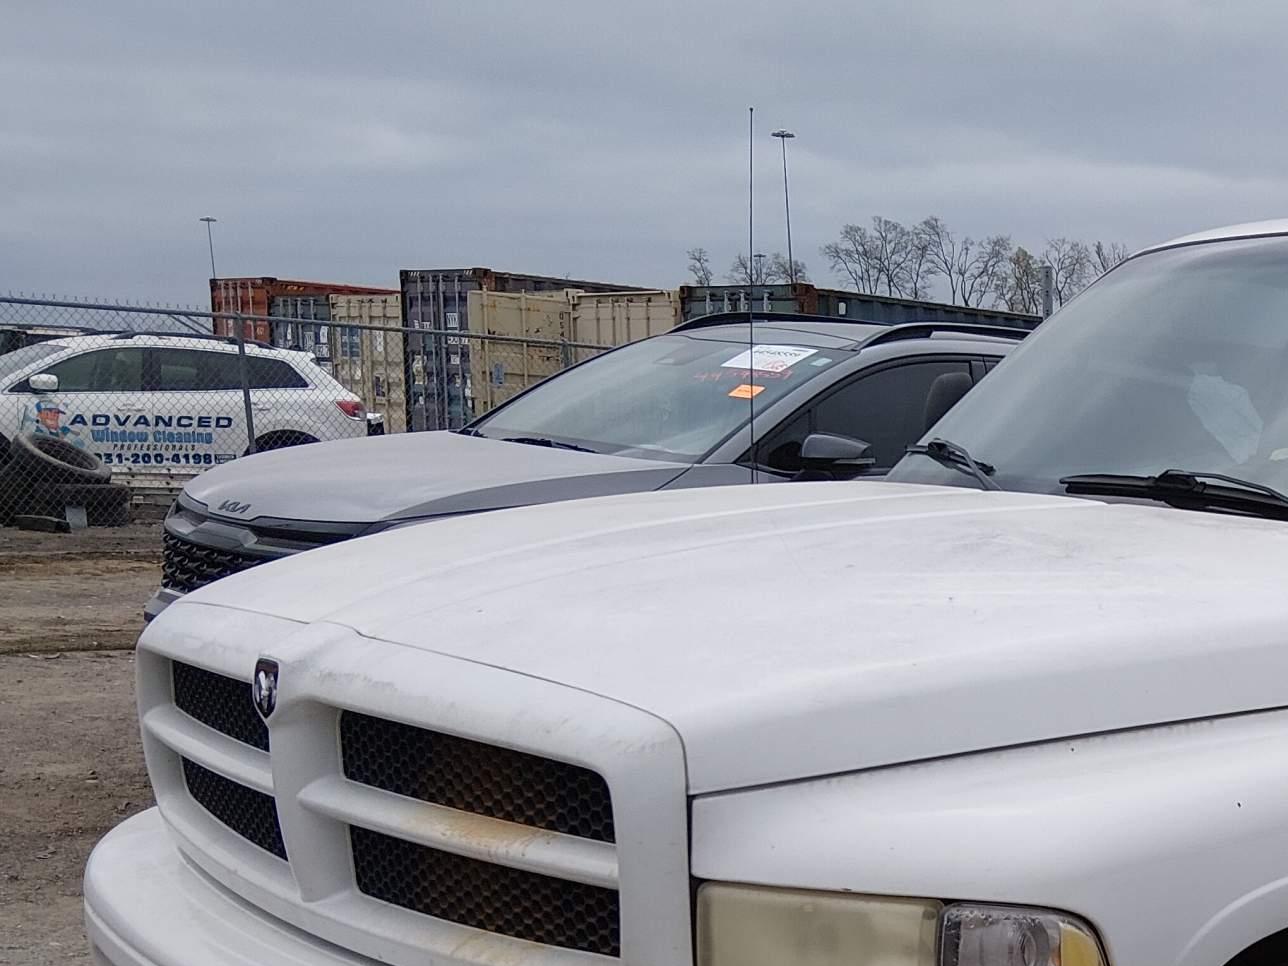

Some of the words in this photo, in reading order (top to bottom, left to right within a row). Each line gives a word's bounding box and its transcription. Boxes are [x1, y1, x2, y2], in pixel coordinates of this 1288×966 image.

[68, 414, 233, 429] ADVANCED
[91, 428, 149, 443] Window
[153, 430, 213, 444] Cleaning
[113, 443, 197, 451] PROFESSIONALS
